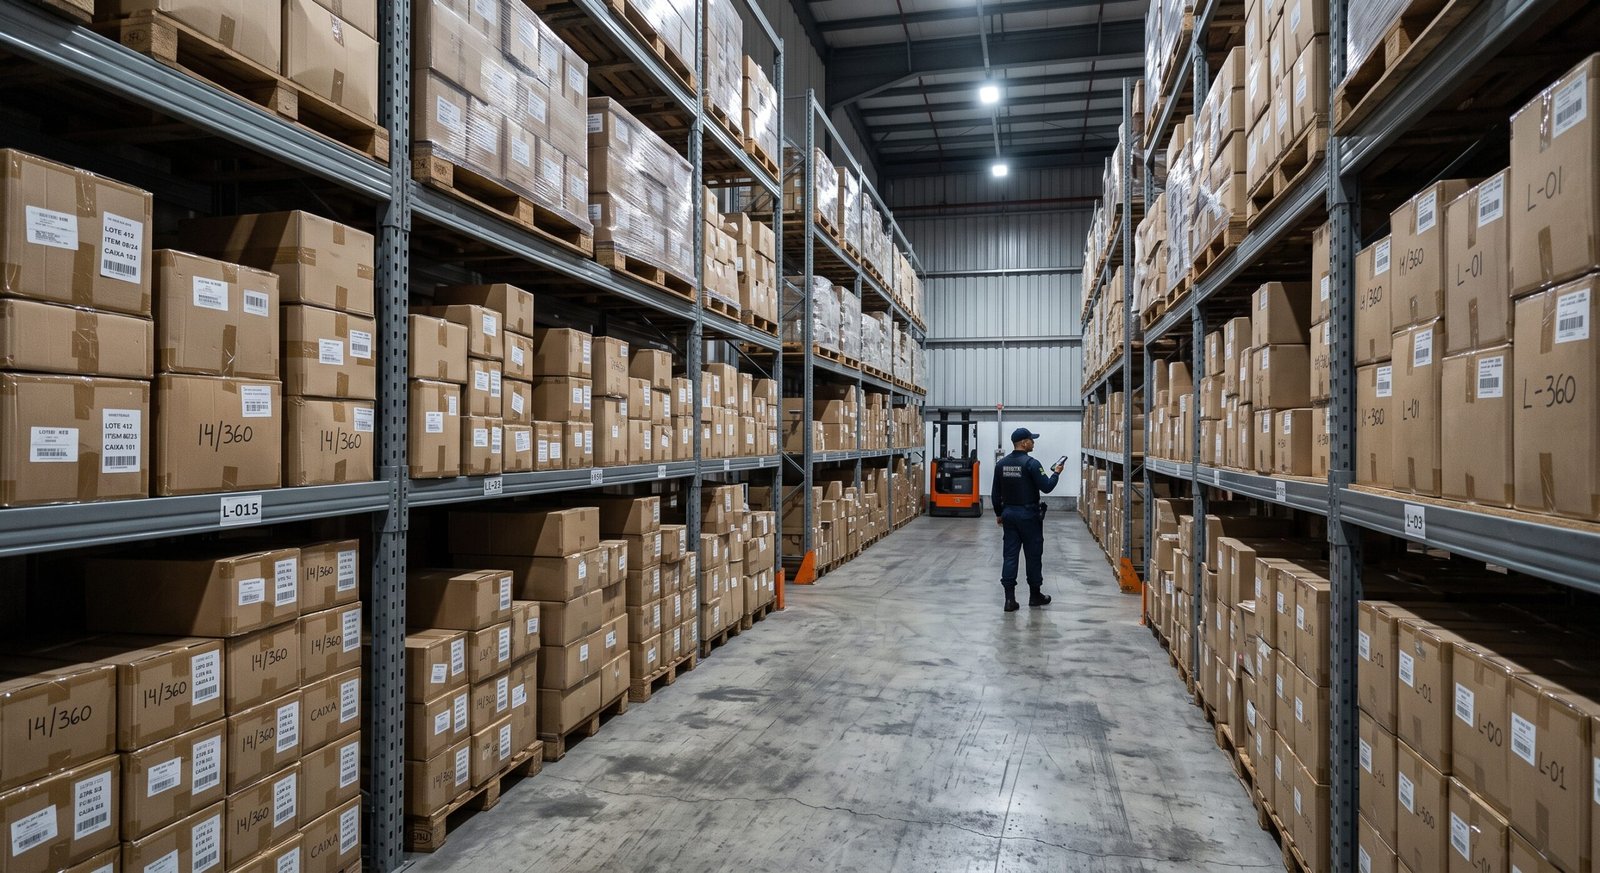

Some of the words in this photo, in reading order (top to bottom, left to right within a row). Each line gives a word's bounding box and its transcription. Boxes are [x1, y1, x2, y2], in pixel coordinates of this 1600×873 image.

[1527, 166, 1562, 212] L-01
[104, 226, 122, 236] LOTE
[123, 231, 135, 239] 412
[104, 236, 121, 247] ITEM
[121, 241, 138, 251] 08/24
[104, 247, 125, 258] CAIXA
[1457, 250, 1482, 286] L-01
[1523, 373, 1576, 409] L-360
[199, 420, 253, 452] 14/360
[320, 427, 362, 454] 14/360
[223, 502, 259, 518] L-015
[306, 566, 334, 582] 14/360
[311, 634, 341, 655] 14/360
[251, 648, 288, 672] 14/360
[144, 681, 187, 709] 14/360
[28, 705, 92, 741] 14/360
[310, 702, 337, 722] CAIXA
[242, 727, 275, 752] 14/360
[1538, 751, 1567, 791] L-01
[236, 807, 270, 835] 14/360
[310, 833, 339, 859] CAIXA
